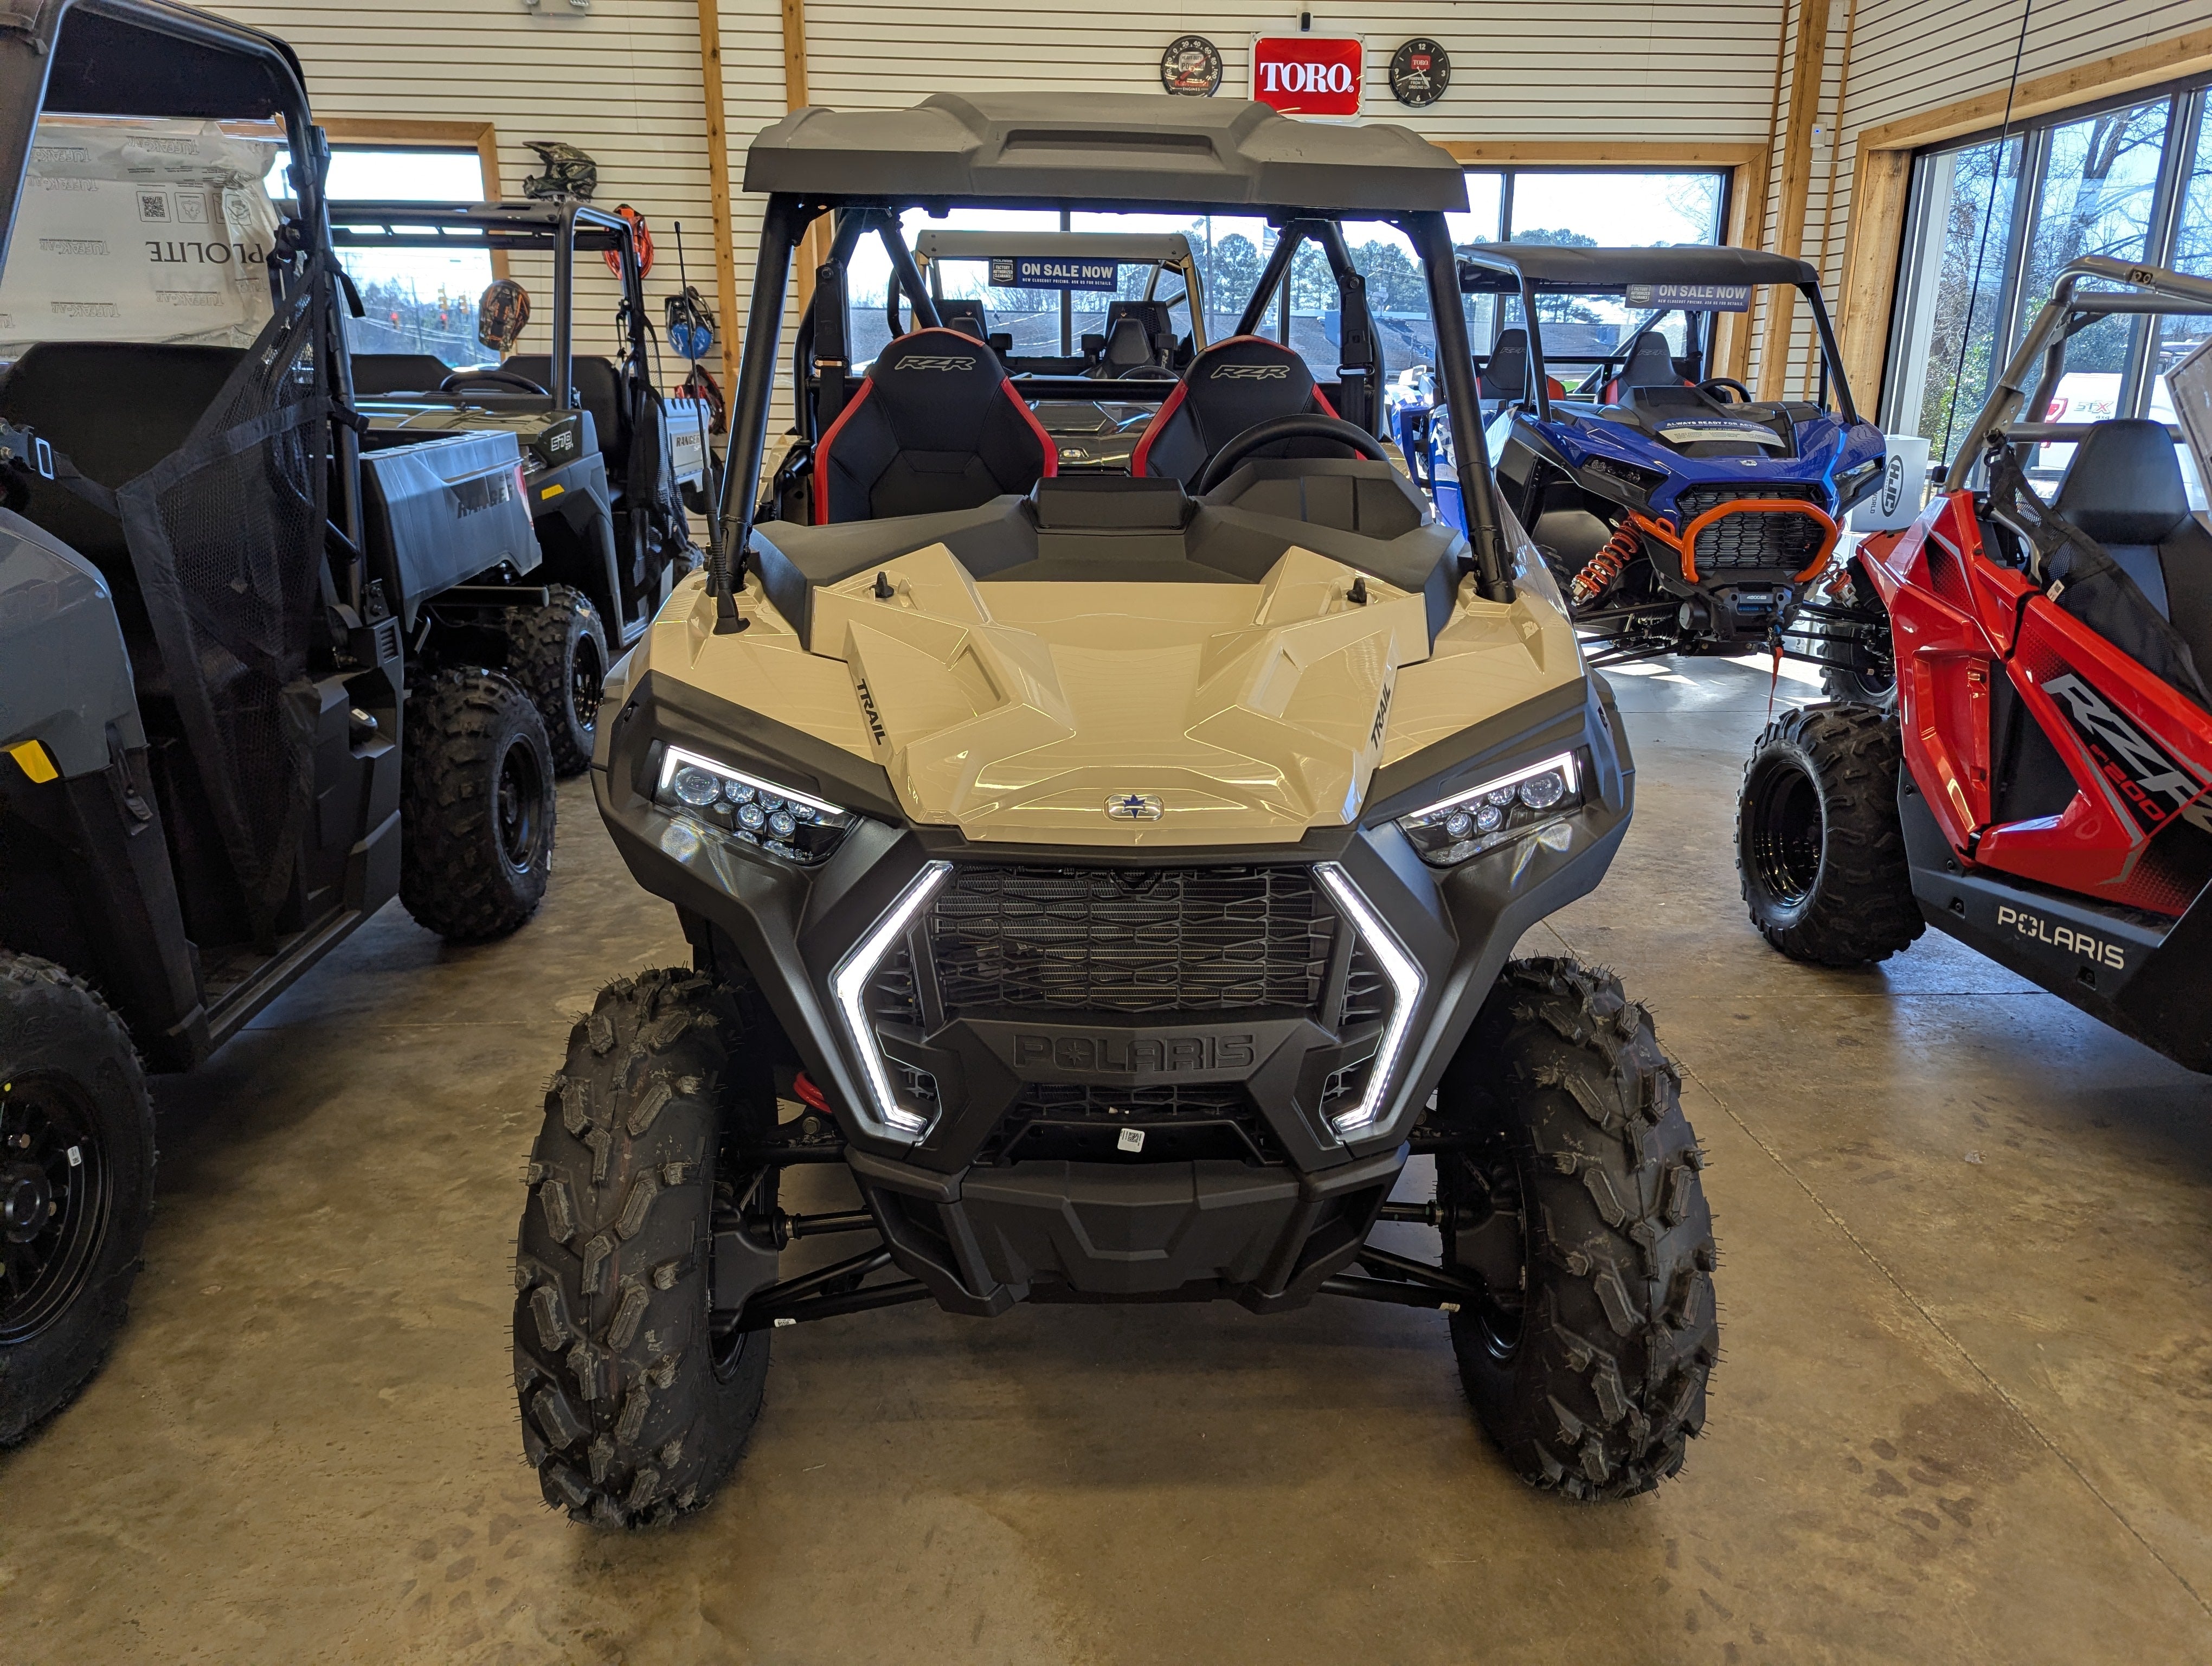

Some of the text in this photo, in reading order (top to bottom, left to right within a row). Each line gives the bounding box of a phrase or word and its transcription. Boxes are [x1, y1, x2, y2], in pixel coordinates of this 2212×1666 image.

[1260, 62, 1352, 93] TORO
[1022, 263, 1113, 278] ON SALE NOW
[1659, 285, 1747, 299] ON SALE NOW
[895, 356, 976, 371] RZR
[1210, 365, 1290, 380] RZR
[2074, 400, 2114, 414] STX
[550, 430, 573, 452] 570
[677, 434, 700, 447] RANGER
[1885, 463, 1900, 509] HJC
[857, 678, 885, 746] TRAIL
[1371, 682, 1391, 751] TRAIL
[2104, 761, 2166, 821] 200
[1997, 905, 2124, 970] POLARIS
[1014, 1034, 1256, 1073] POLARIS
